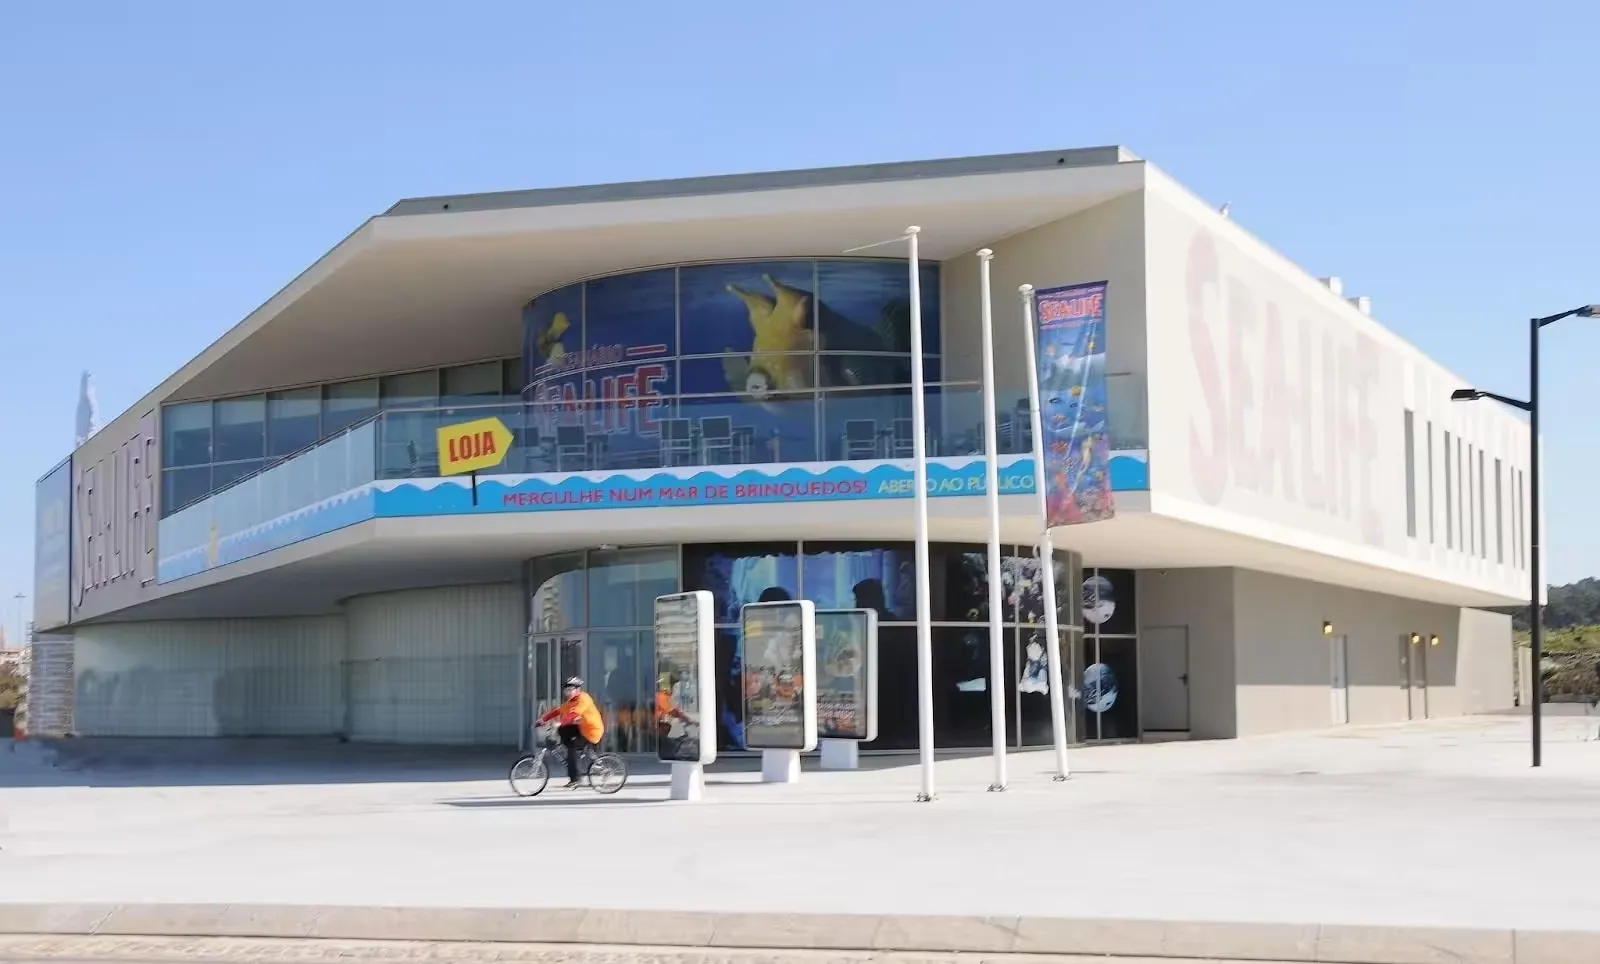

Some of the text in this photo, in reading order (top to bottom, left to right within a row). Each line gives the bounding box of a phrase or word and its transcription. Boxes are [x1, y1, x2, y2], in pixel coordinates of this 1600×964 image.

[449, 431, 496, 462] LOJA
[503, 473, 1034, 506] MERGULHE NUM MAR DE BRINQUEDOS! ABERO AO PÚLICO
